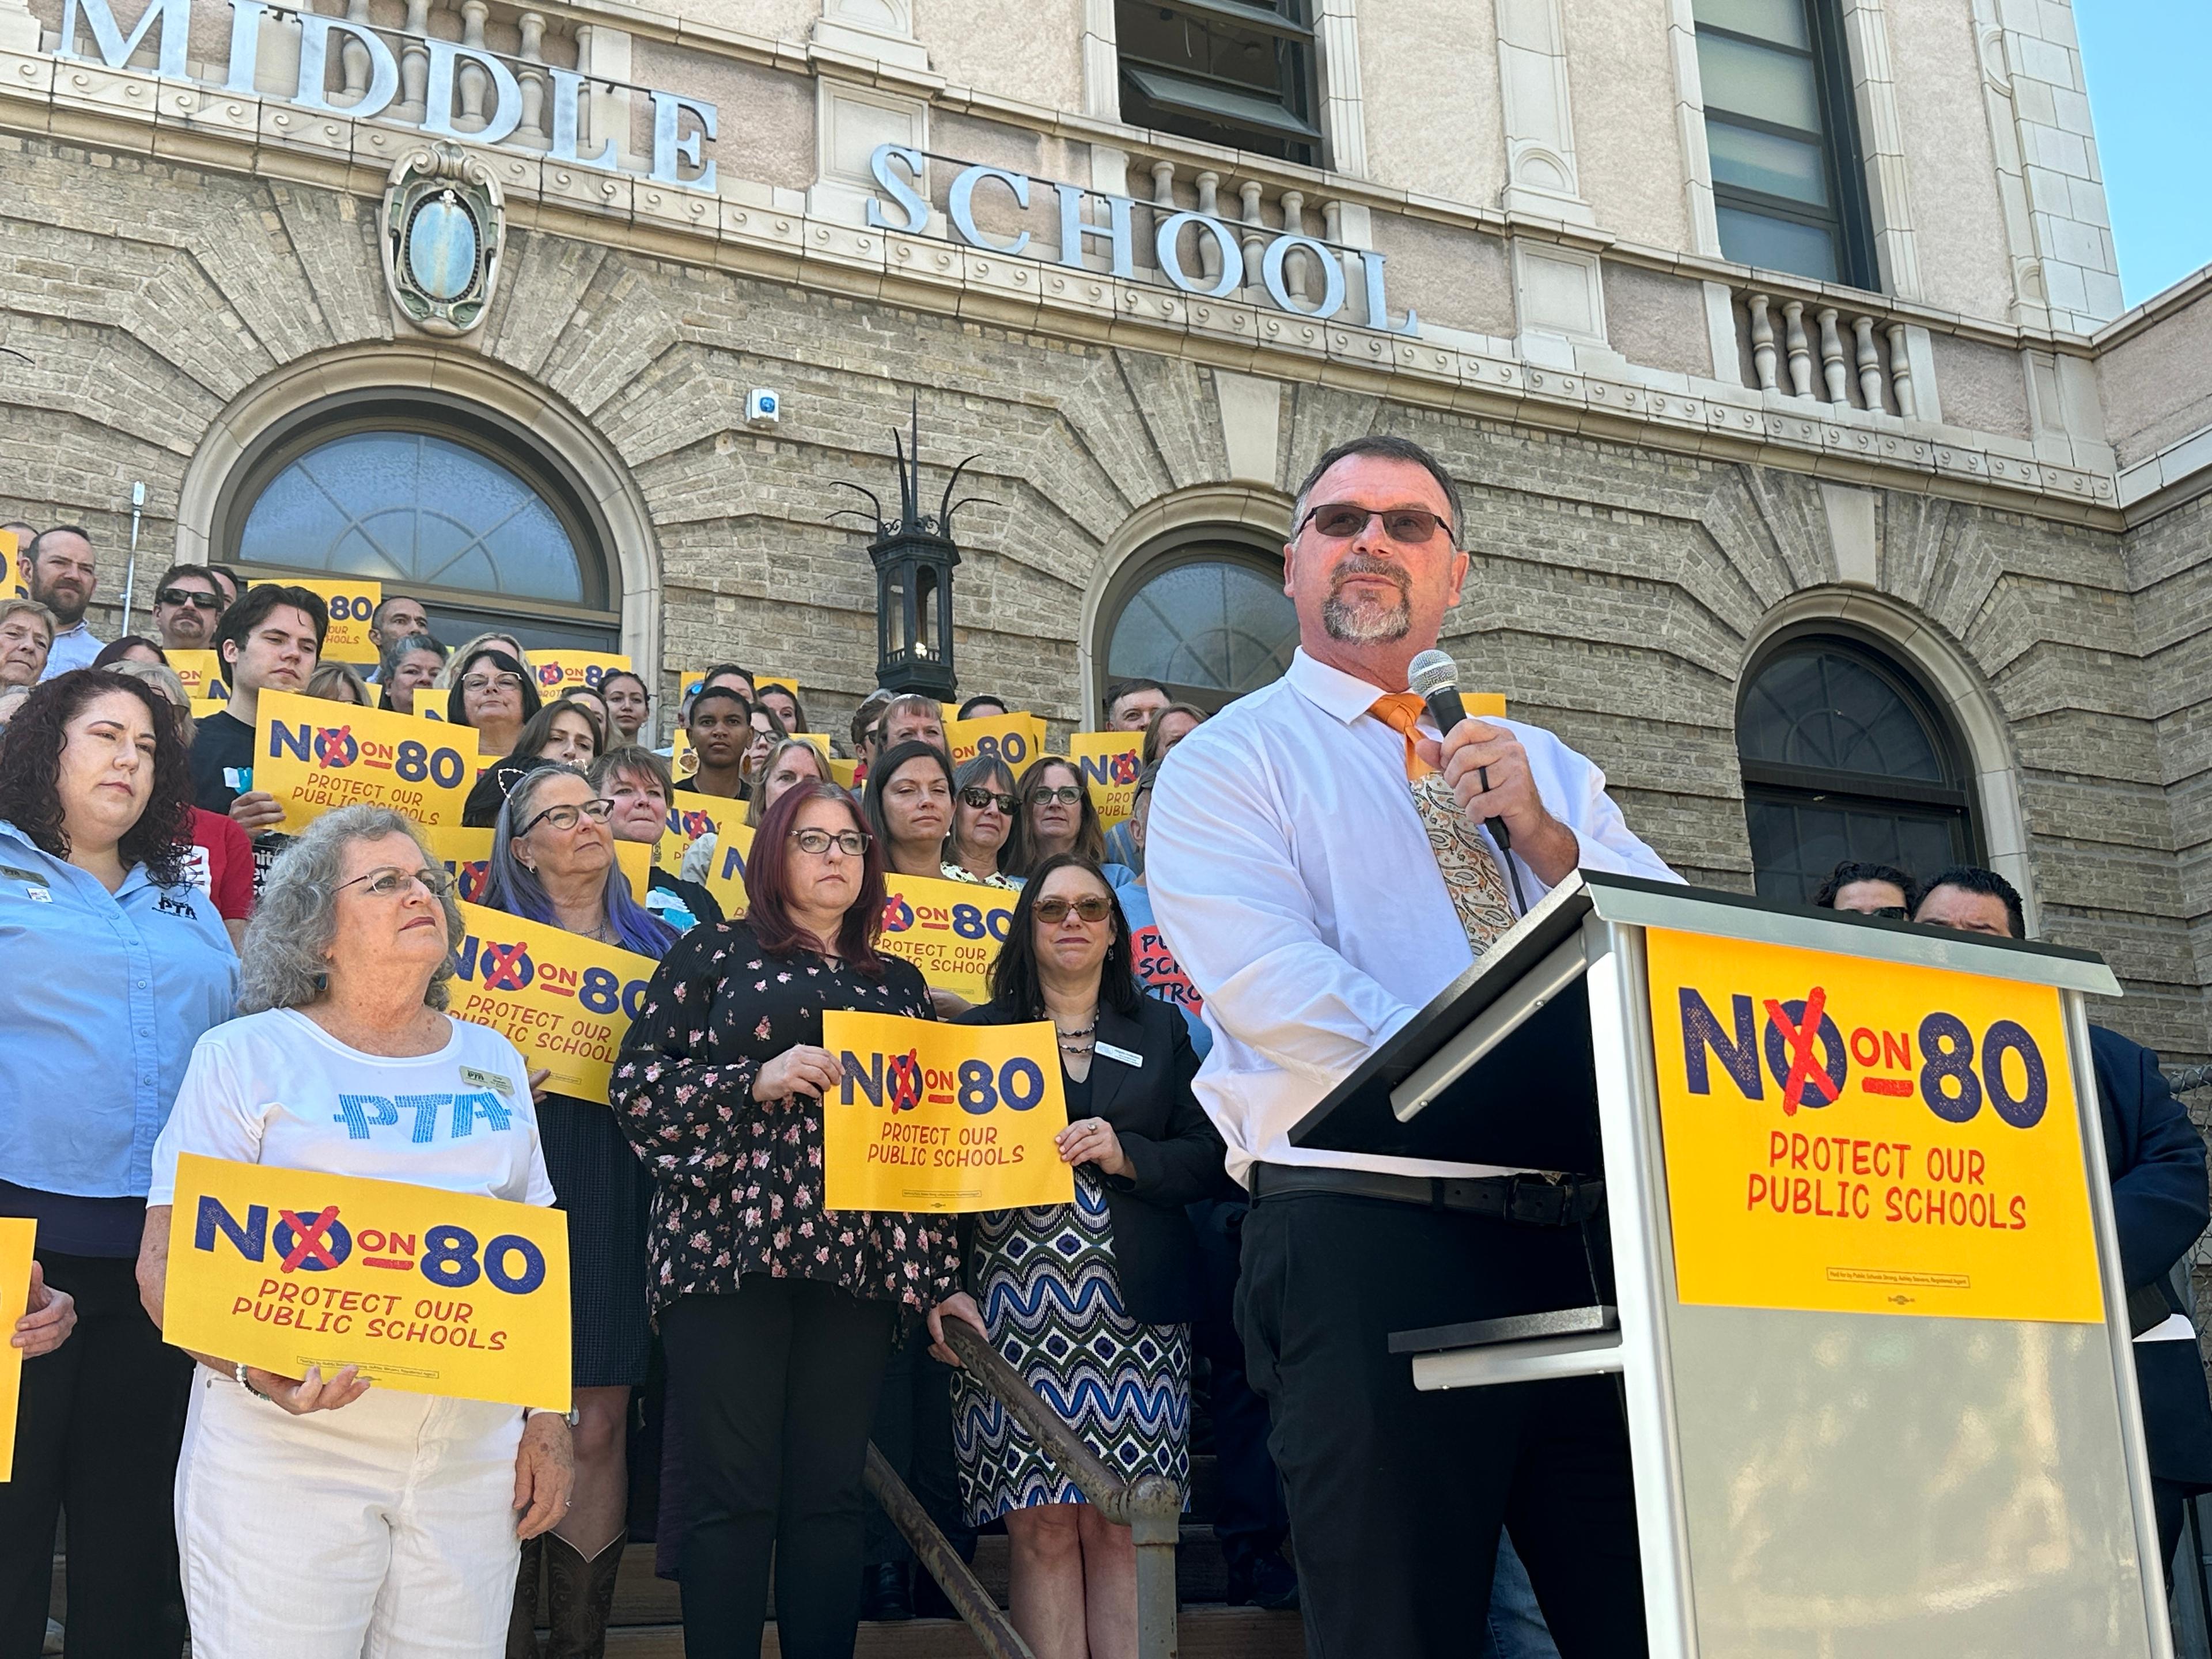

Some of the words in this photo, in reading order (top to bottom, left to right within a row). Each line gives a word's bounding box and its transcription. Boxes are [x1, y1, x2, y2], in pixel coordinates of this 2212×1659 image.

[52, 0, 718, 193] MIDDLE
[866, 143, 1419, 337] SCHOOL
[329, 595, 373, 621] 80
[325, 635, 360, 645] HOOLS
[328, 626, 348, 634] OUR
[178, 671, 202, 679] ON
[565, 668, 584, 676] ON
[585, 665, 620, 687] 8
[270, 719, 359, 769] NO
[361, 741, 393, 760] ON
[395, 740, 464, 789] 80
[952, 745, 975, 758] ON
[977, 732, 1027, 764] 80
[1080, 748, 1141, 788] NO
[308, 772, 384, 798] PROTECT
[391, 789, 423, 806] OUR
[158, 892, 198, 921] PTA
[916, 906, 949, 922] ON
[952, 903, 1014, 942] 80
[454, 934, 535, 991] NO
[538, 963, 578, 987] ON
[872, 938, 947, 957] PROTECT
[955, 946, 987, 961] OUR
[930, 959, 996, 976] SCHOOL
[465, 994, 564, 1031] PROTECT
[571, 1020, 611, 1043] OUR
[535, 1032, 616, 1063] SCHOOL
[1678, 986, 1849, 1117] NO
[1850, 1027, 1912, 1071] ON
[1919, 1012, 2048, 1130] 80
[840, 1048, 923, 1115] NO
[925, 1069, 953, 1090] ON
[957, 1056, 1046, 1115] 80
[333, 1092, 513, 1143] PTA
[881, 1122, 949, 1145] PROTECT
[959, 1126, 998, 1146] OUR
[866, 1142, 926, 1166] PUBLIC
[933, 1145, 1025, 1168] SCHOOLS
[1769, 1131, 1912, 1180] PROTECT
[1927, 1147, 1986, 1185] OUR
[1747, 1174, 1871, 1220] PUBLIC
[1885, 1187, 2027, 1230] SCHOOLS
[194, 1194, 352, 1274] NO
[357, 1229, 415, 1257] ON
[420, 1224, 547, 1295] 80
[258, 1278, 403, 1316] PROTECT
[414, 1299, 474, 1323] OUR
[232, 1297, 353, 1334] PUBLIC
[365, 1317, 507, 1351] SCHOOLS
